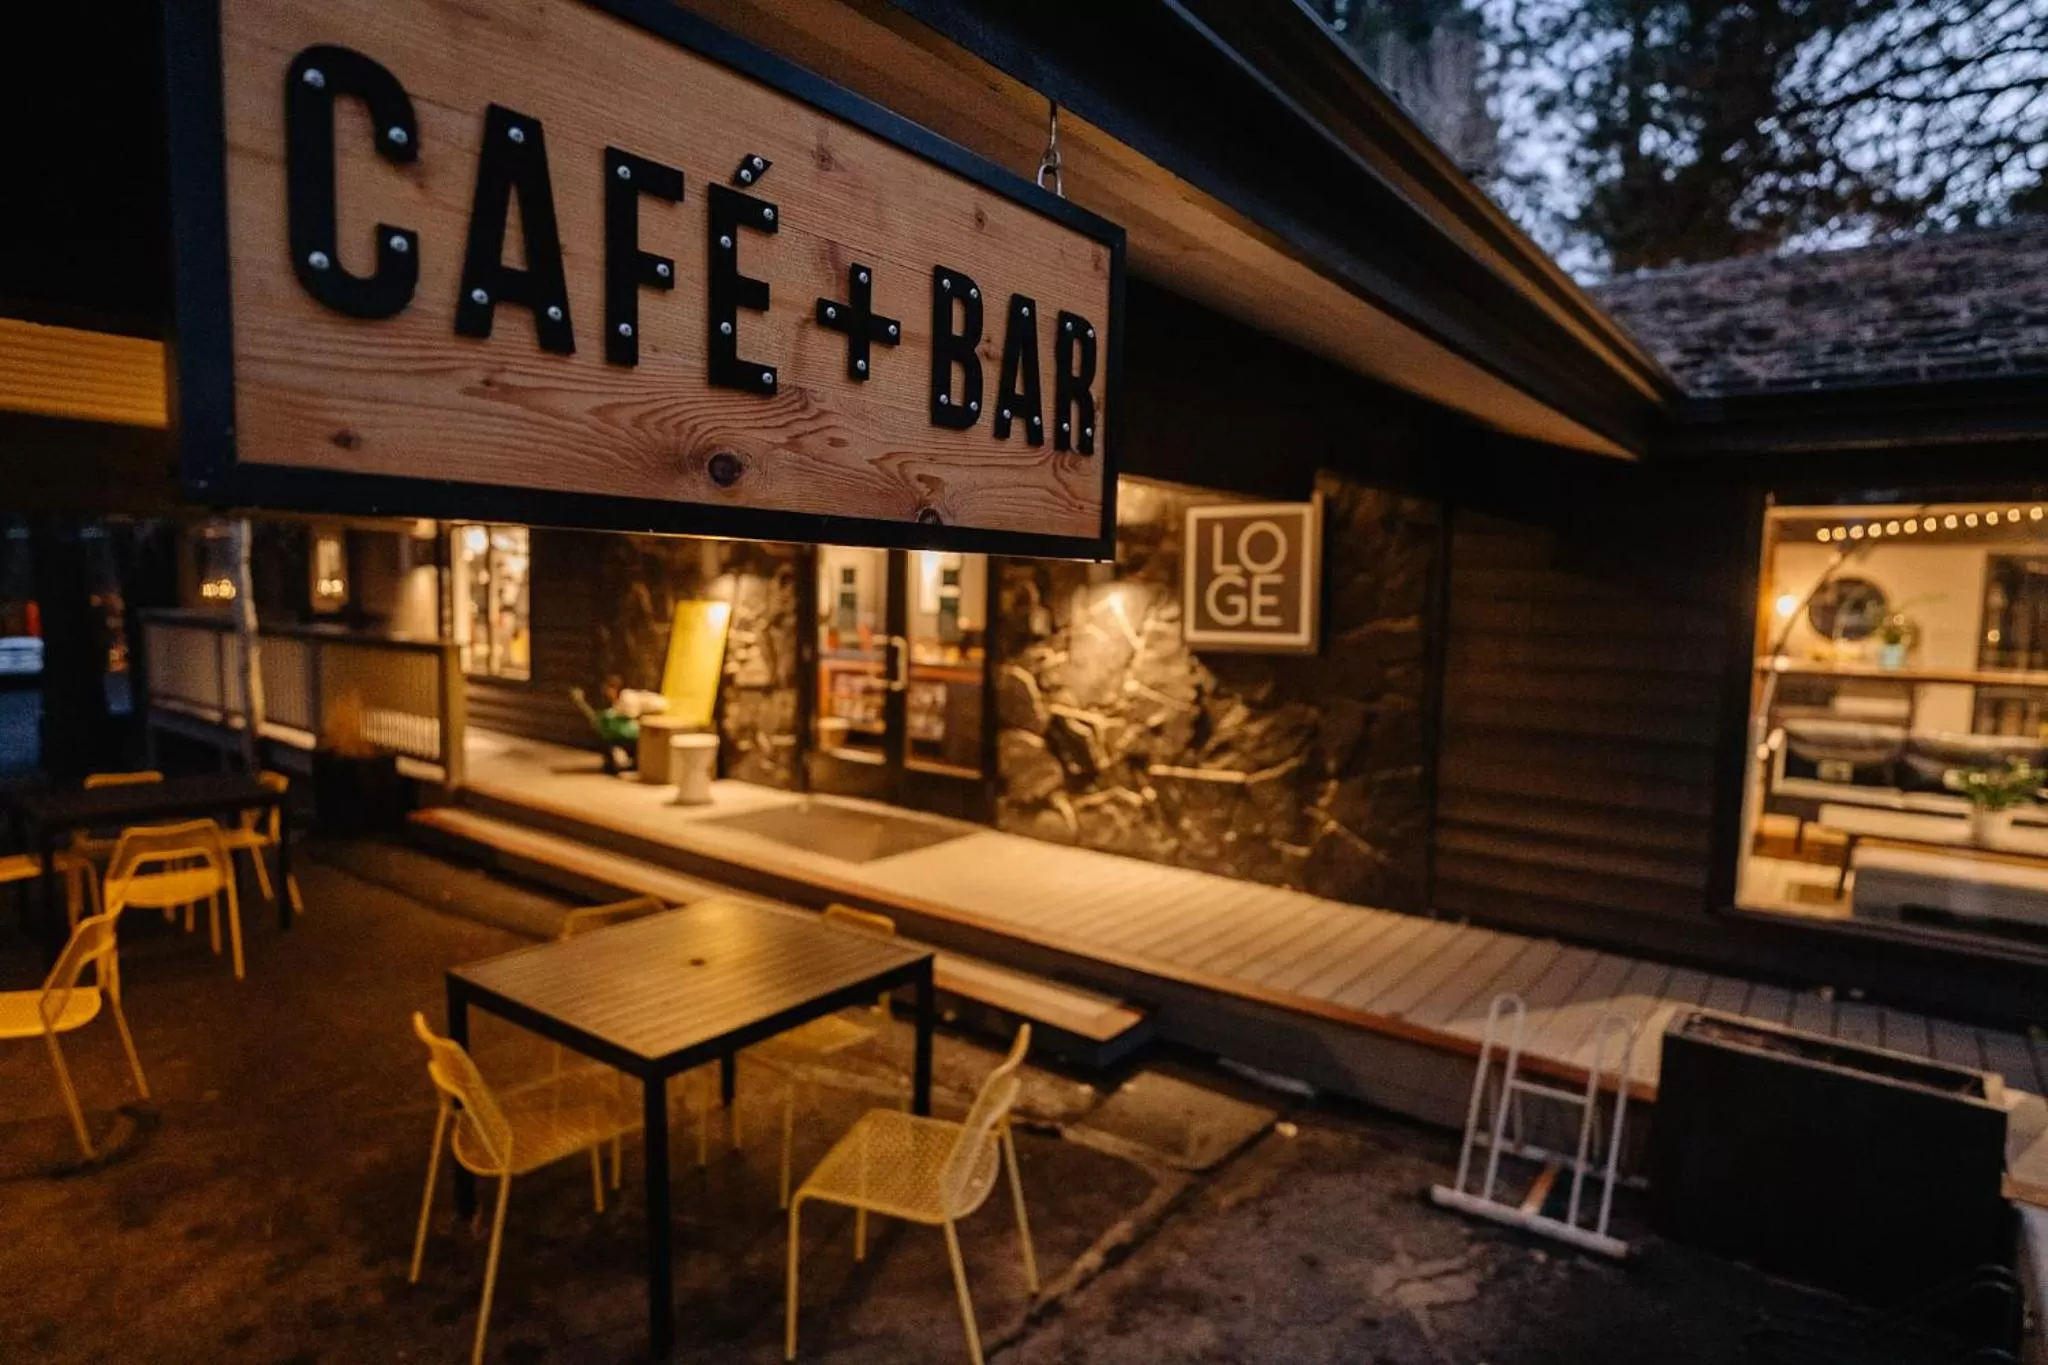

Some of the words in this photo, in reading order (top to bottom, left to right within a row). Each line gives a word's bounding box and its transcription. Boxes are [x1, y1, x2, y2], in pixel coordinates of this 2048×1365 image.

[284, 42, 778, 396] CAFÉ
[816, 262, 900, 382] +
[930, 264, 1097, 454] BAR
[1212, 520, 1288, 574] LO
[1205, 573, 1285, 627] GE
